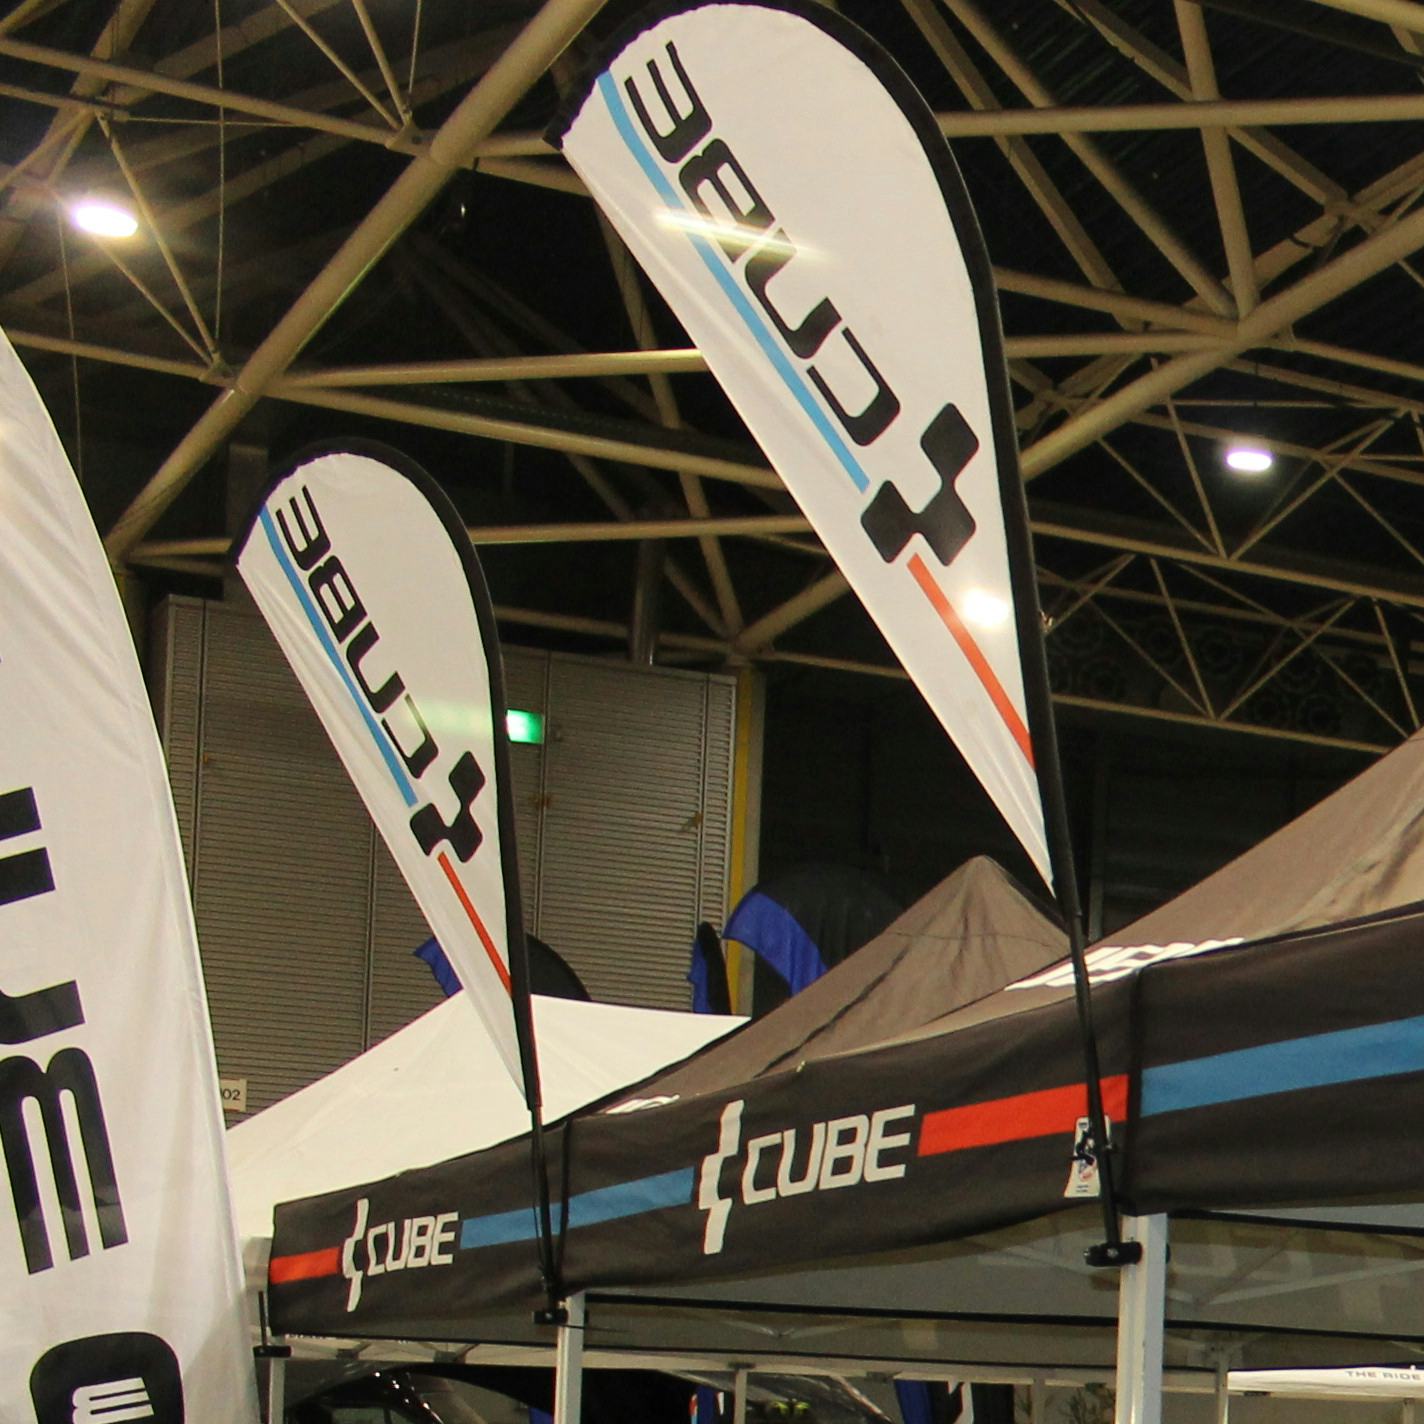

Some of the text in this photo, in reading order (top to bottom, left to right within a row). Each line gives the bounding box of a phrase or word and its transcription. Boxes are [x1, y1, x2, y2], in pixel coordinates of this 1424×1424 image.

[221, 1088, 241, 1100] 02
[741, 1104, 915, 1205] CUBE
[366, 1212, 458, 1277] CUBE
[1345, 1370, 1377, 1378] THE
[1383, 1372, 1421, 1380] RIDE
